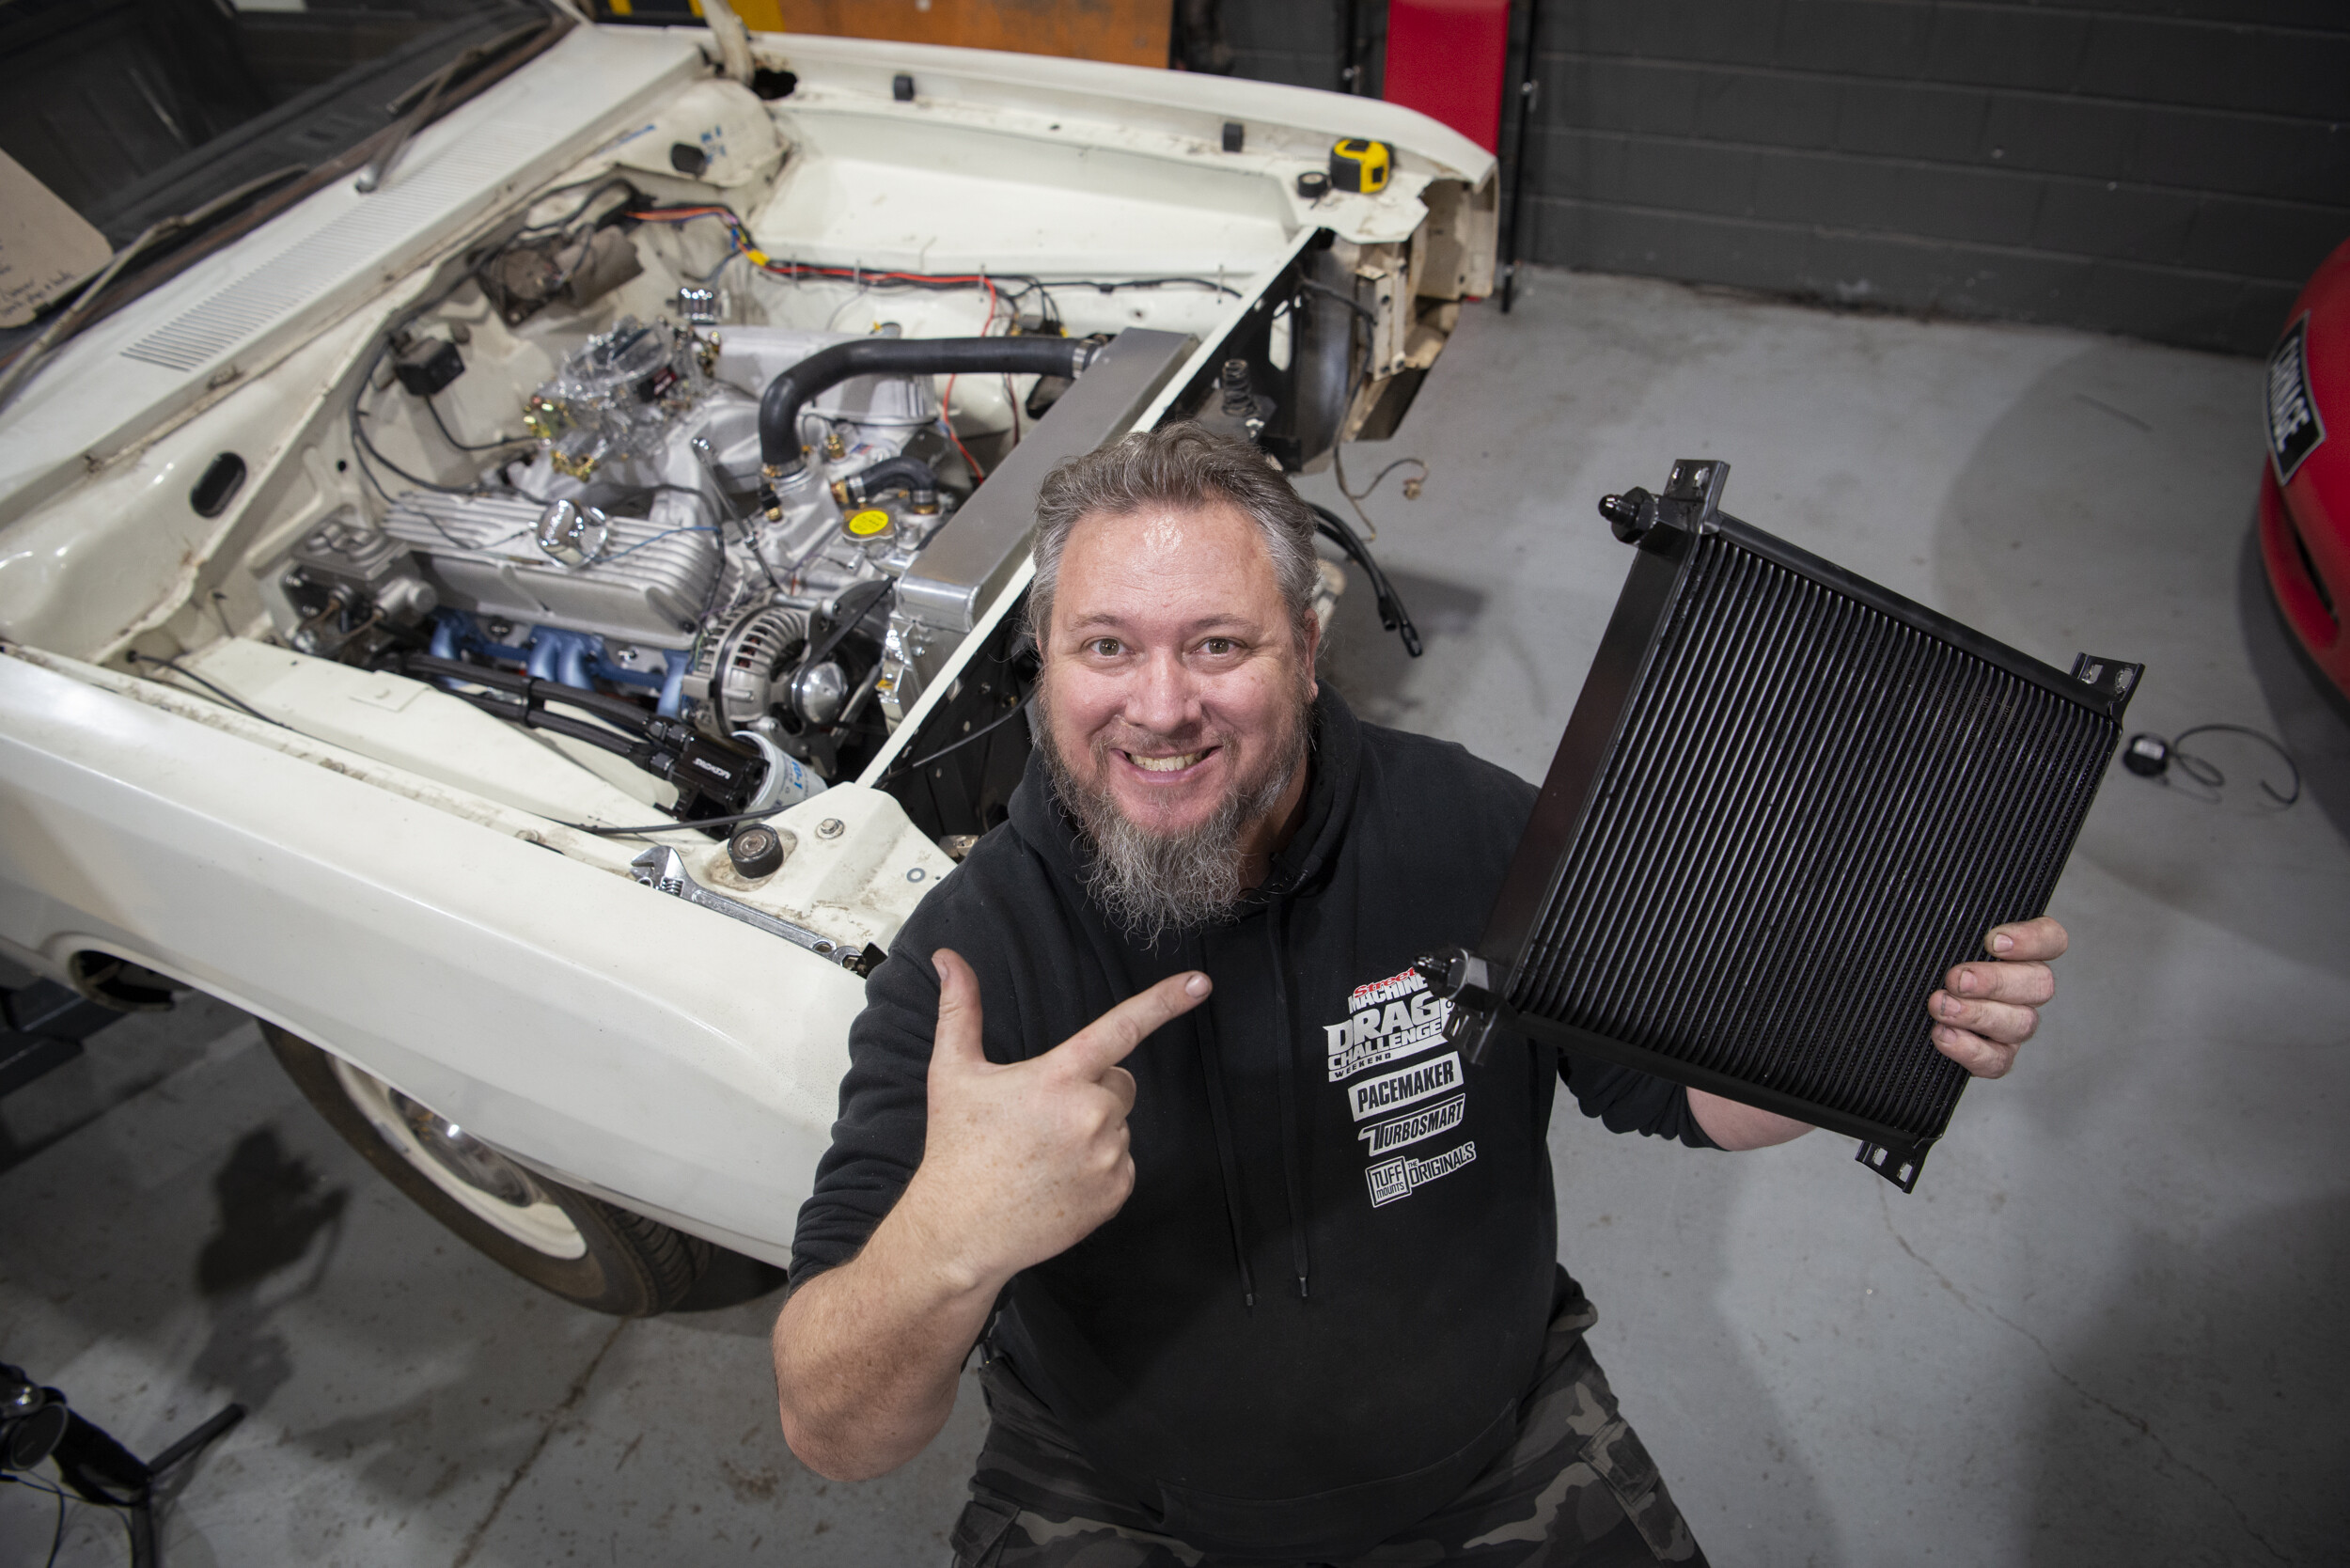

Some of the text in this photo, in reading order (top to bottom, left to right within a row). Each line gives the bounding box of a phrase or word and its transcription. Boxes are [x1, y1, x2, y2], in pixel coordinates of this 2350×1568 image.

[1348, 973, 1428, 1014] MACHINE
[1354, 966, 1417, 998] Street
[1323, 990, 1441, 1055] DRAG
[1328, 1018, 1442, 1071] CHALLENGE
[1335, 1052, 1391, 1078] WEEKEND
[1357, 1059, 1454, 1113] PACEMAKER
[1363, 1095, 1464, 1151] TURBOSMART
[1372, 1164, 1402, 1188] TUFF
[1407, 1160, 1418, 1168] THE
[1408, 1143, 1475, 1185] ORIGINALS
